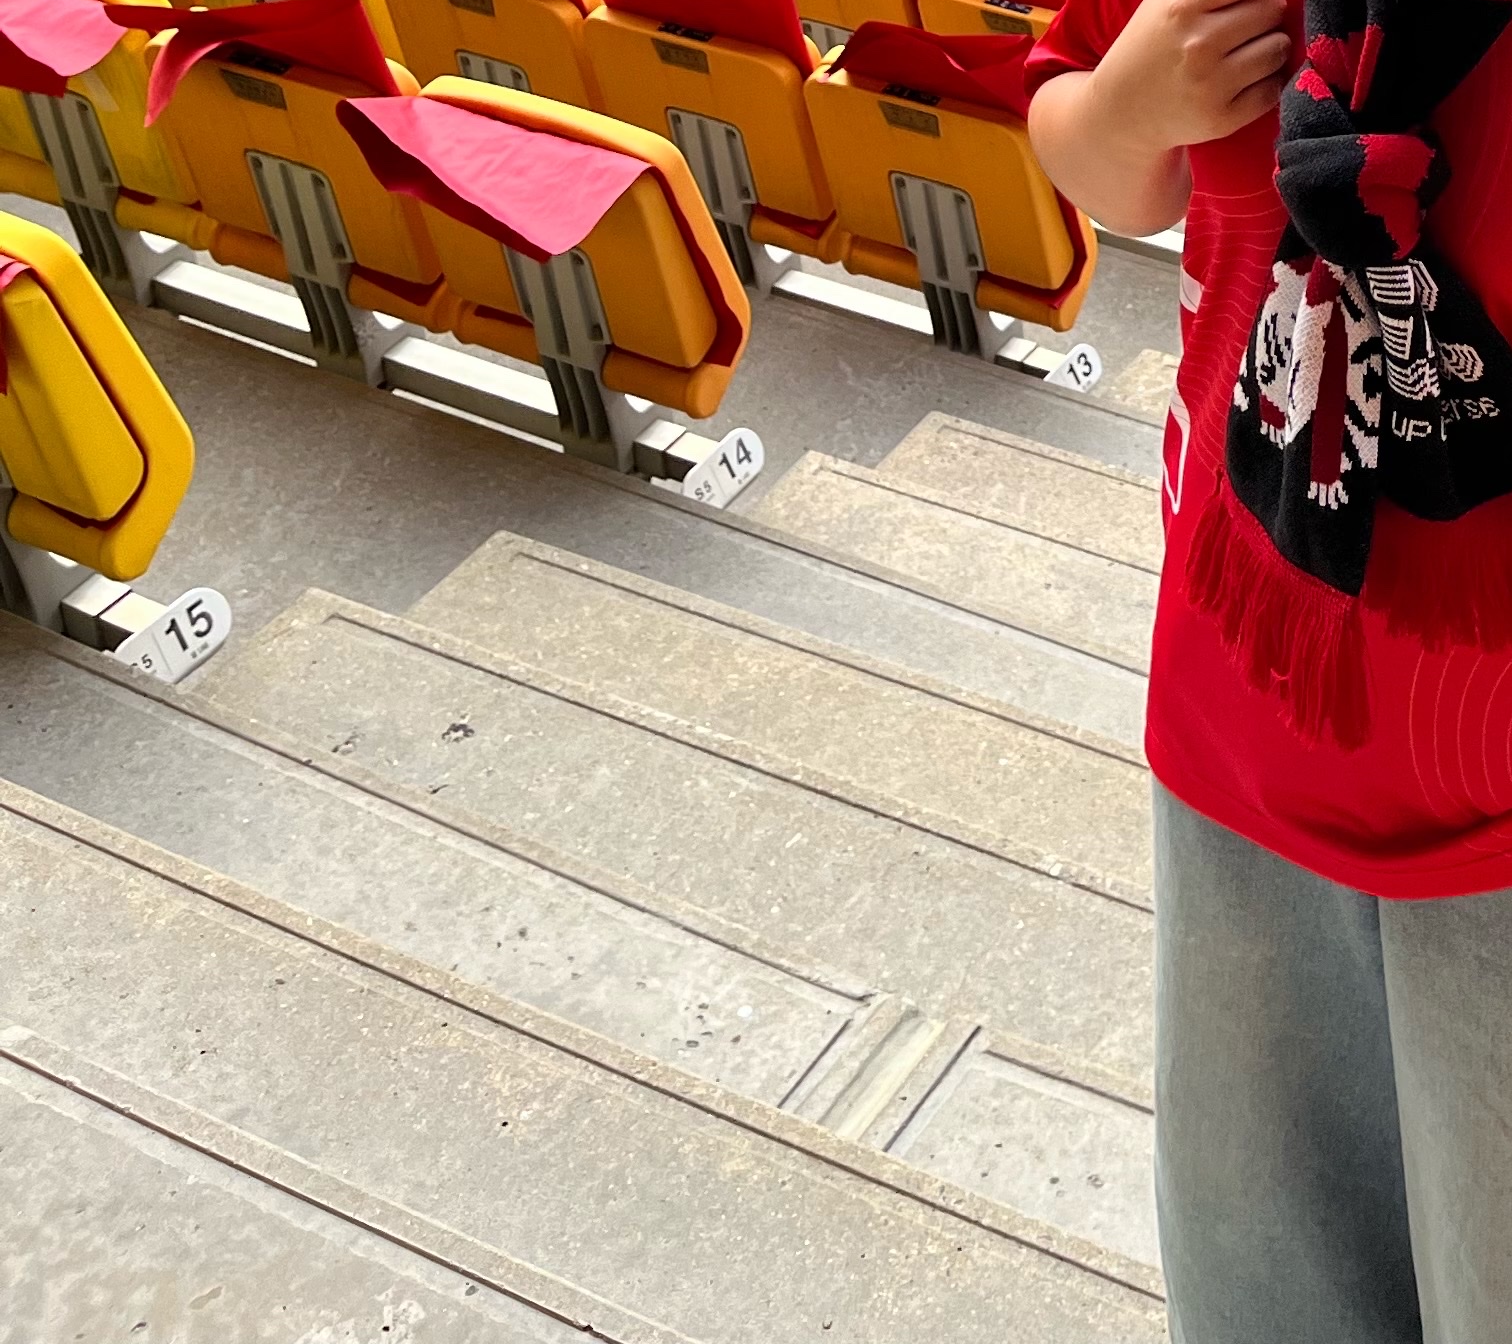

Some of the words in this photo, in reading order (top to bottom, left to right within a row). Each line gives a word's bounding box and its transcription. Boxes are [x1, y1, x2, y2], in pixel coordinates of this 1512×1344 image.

[1067, 352, 1092, 385] 13
[718, 437, 752, 479] 14
[164, 599, 213, 652] 15
